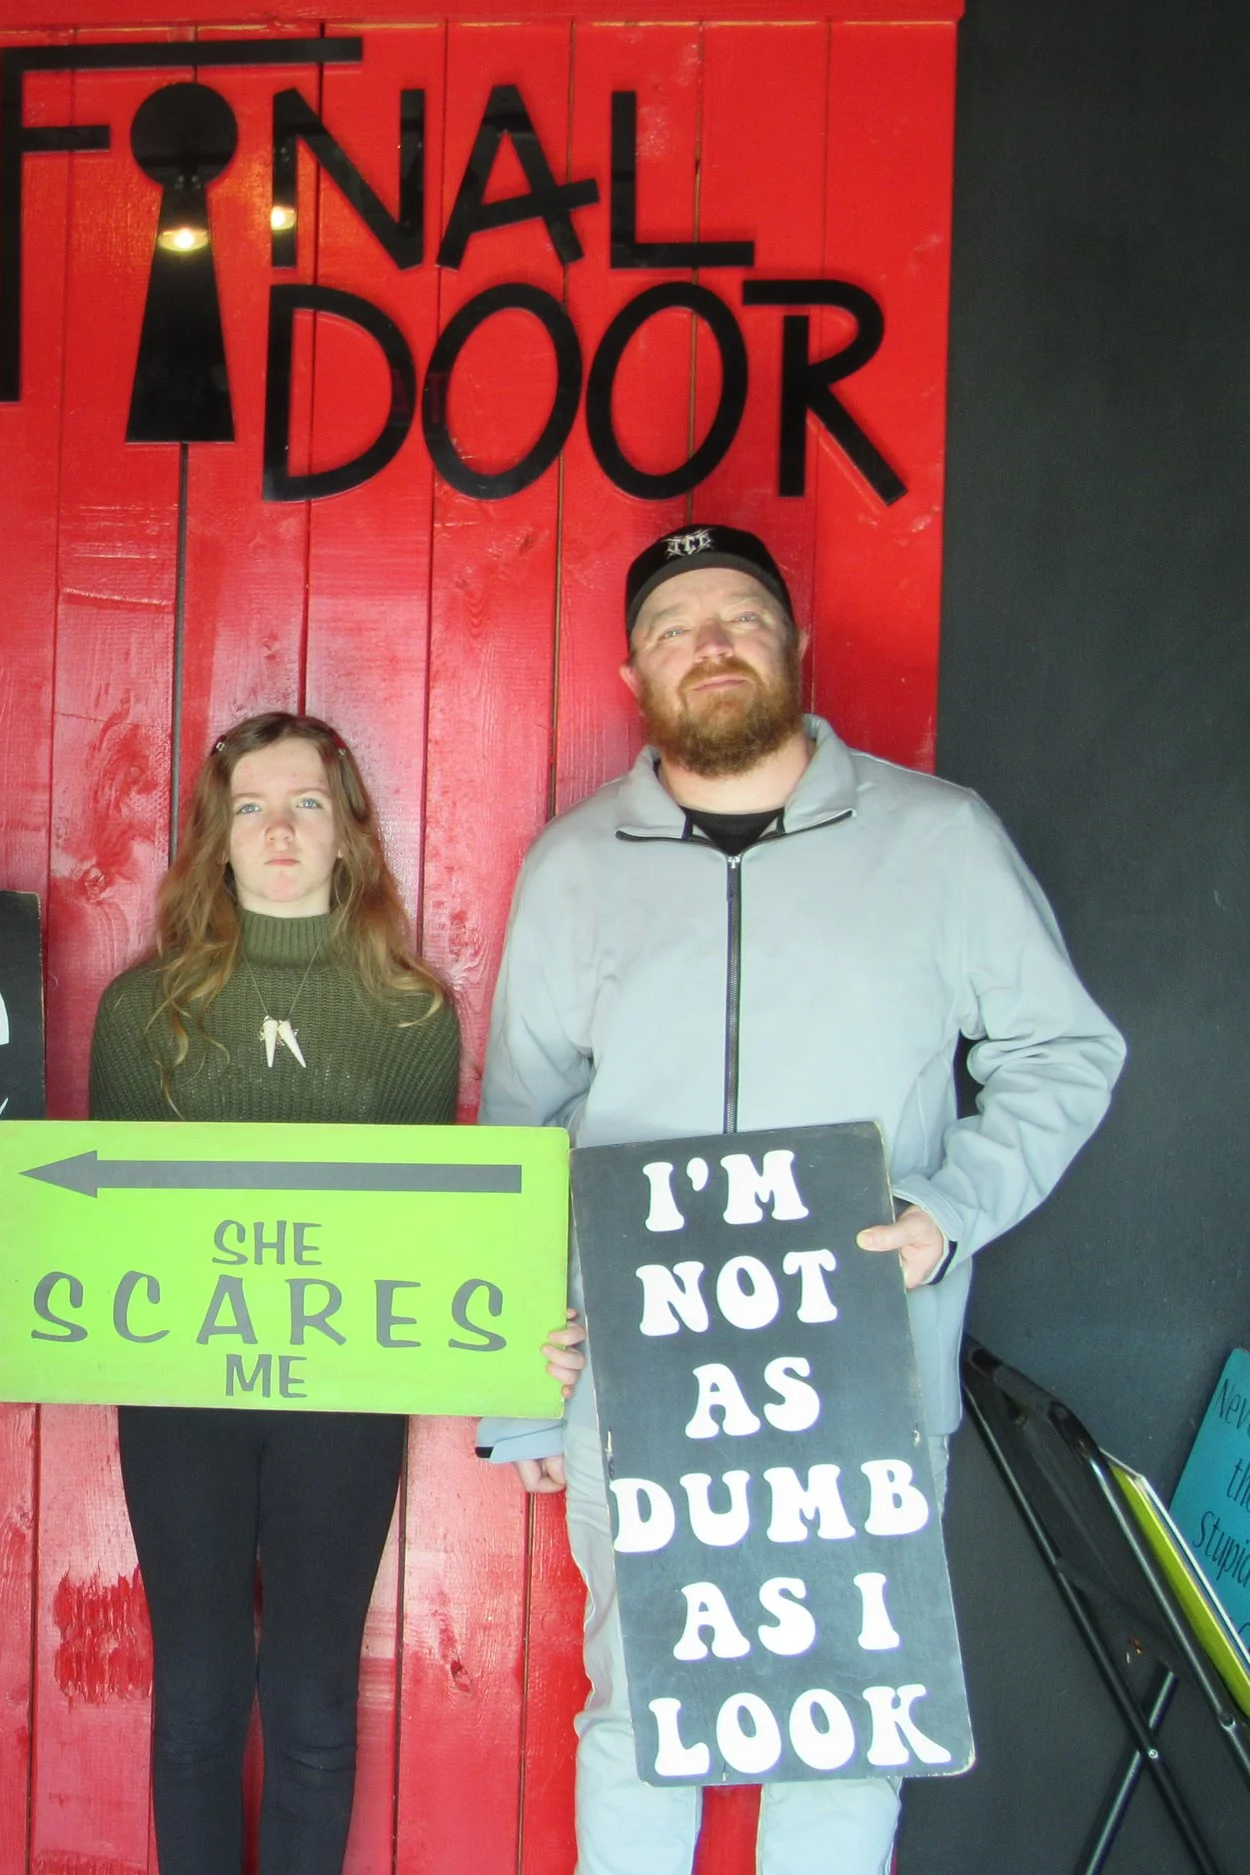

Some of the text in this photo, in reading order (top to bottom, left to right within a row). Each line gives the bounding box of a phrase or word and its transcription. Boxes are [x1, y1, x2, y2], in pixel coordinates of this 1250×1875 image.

[262, 279, 908, 506] DOOR
[643, 1149, 809, 1231] I'M
[212, 1219, 322, 1266] SHE
[31, 1270, 507, 1352] SCARES
[636, 1249, 838, 1336] NOT
[225, 1355, 308, 1399] ME
[685, 1357, 820, 1439] AS
[1212, 1378, 1250, 1438] Nev
[610, 1459, 930, 1553] DUMB
[673, 1572, 901, 1661] AS I
[649, 1684, 952, 1776] LOOK
